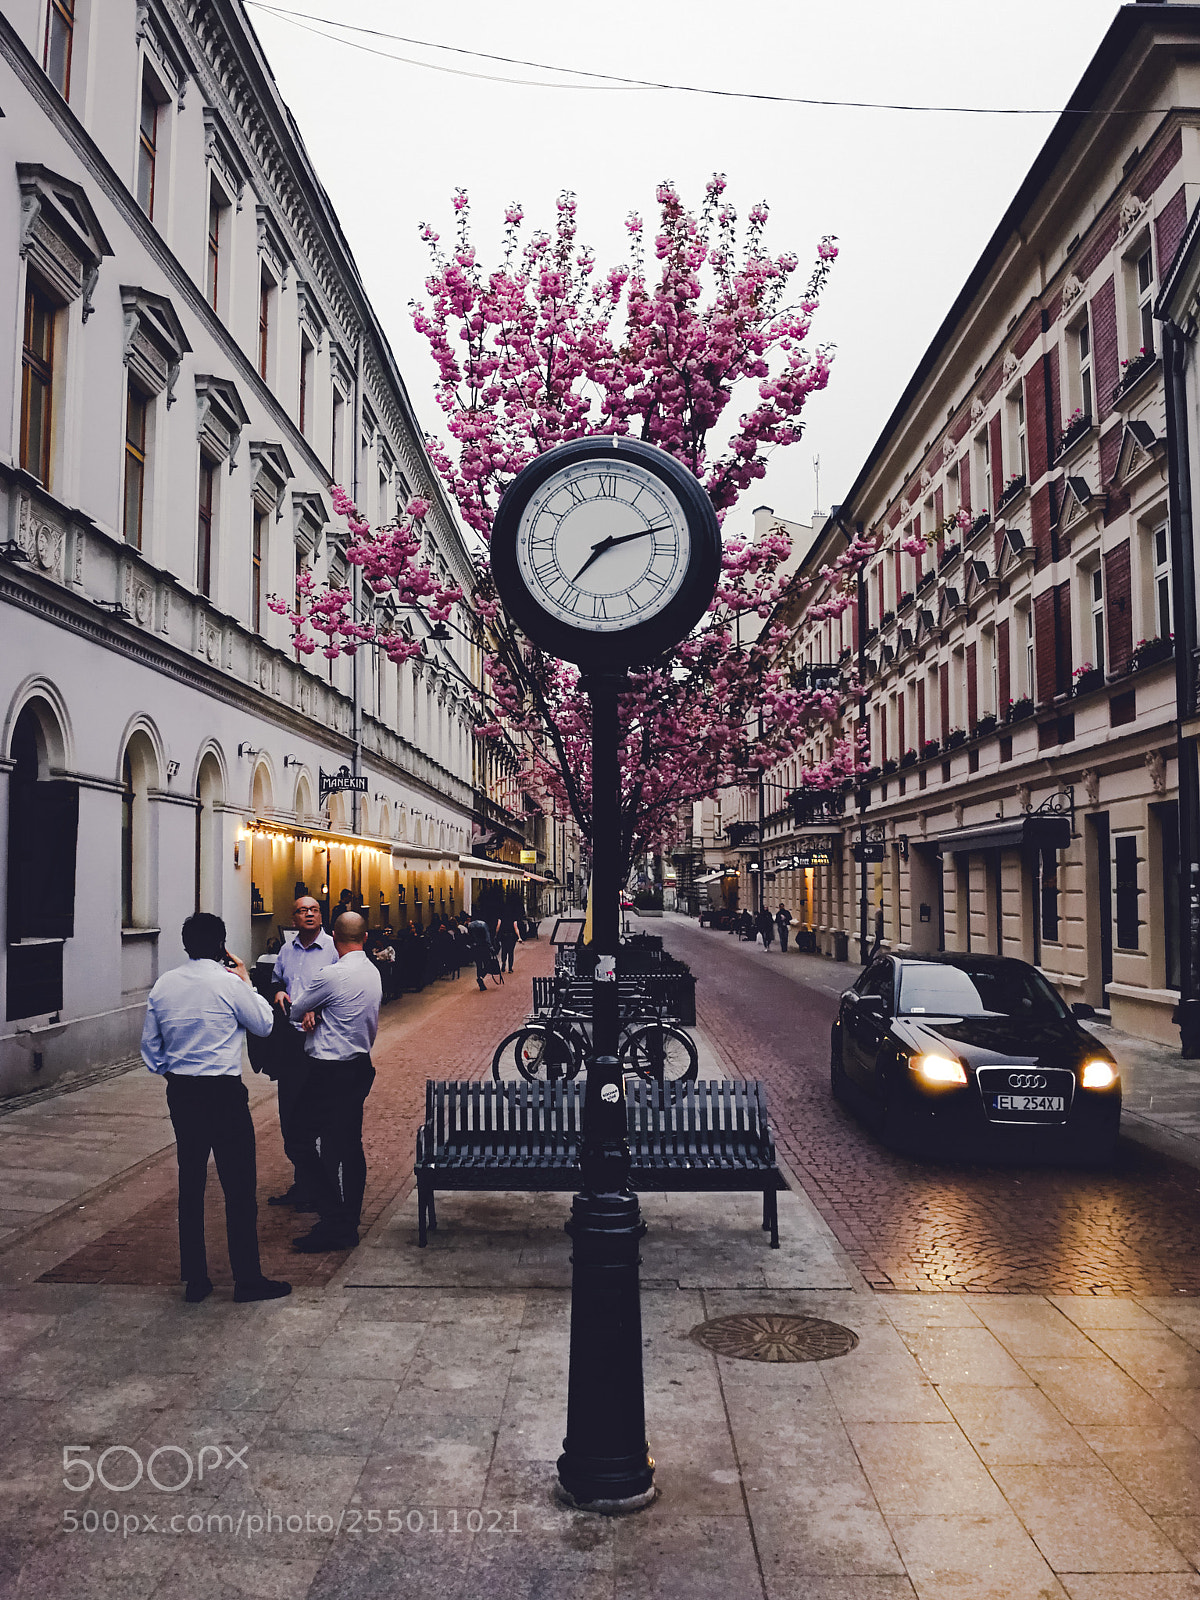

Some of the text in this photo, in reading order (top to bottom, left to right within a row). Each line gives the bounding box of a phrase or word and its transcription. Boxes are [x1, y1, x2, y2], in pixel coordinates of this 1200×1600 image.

[563, 480, 587, 506] XI
[595, 475, 617, 498] XII
[541, 503, 565, 525] X
[646, 510, 671, 527] II
[531, 535, 554, 551] IX
[653, 543, 677, 557] III
[534, 558, 563, 590] VIII
[556, 584, 581, 612] VII
[591, 596, 608, 619] VI
[625, 590, 642, 613] V
[322, 778, 366, 790] MANEKIN
[999, 1096, 1062, 1110] EL 254XJ
